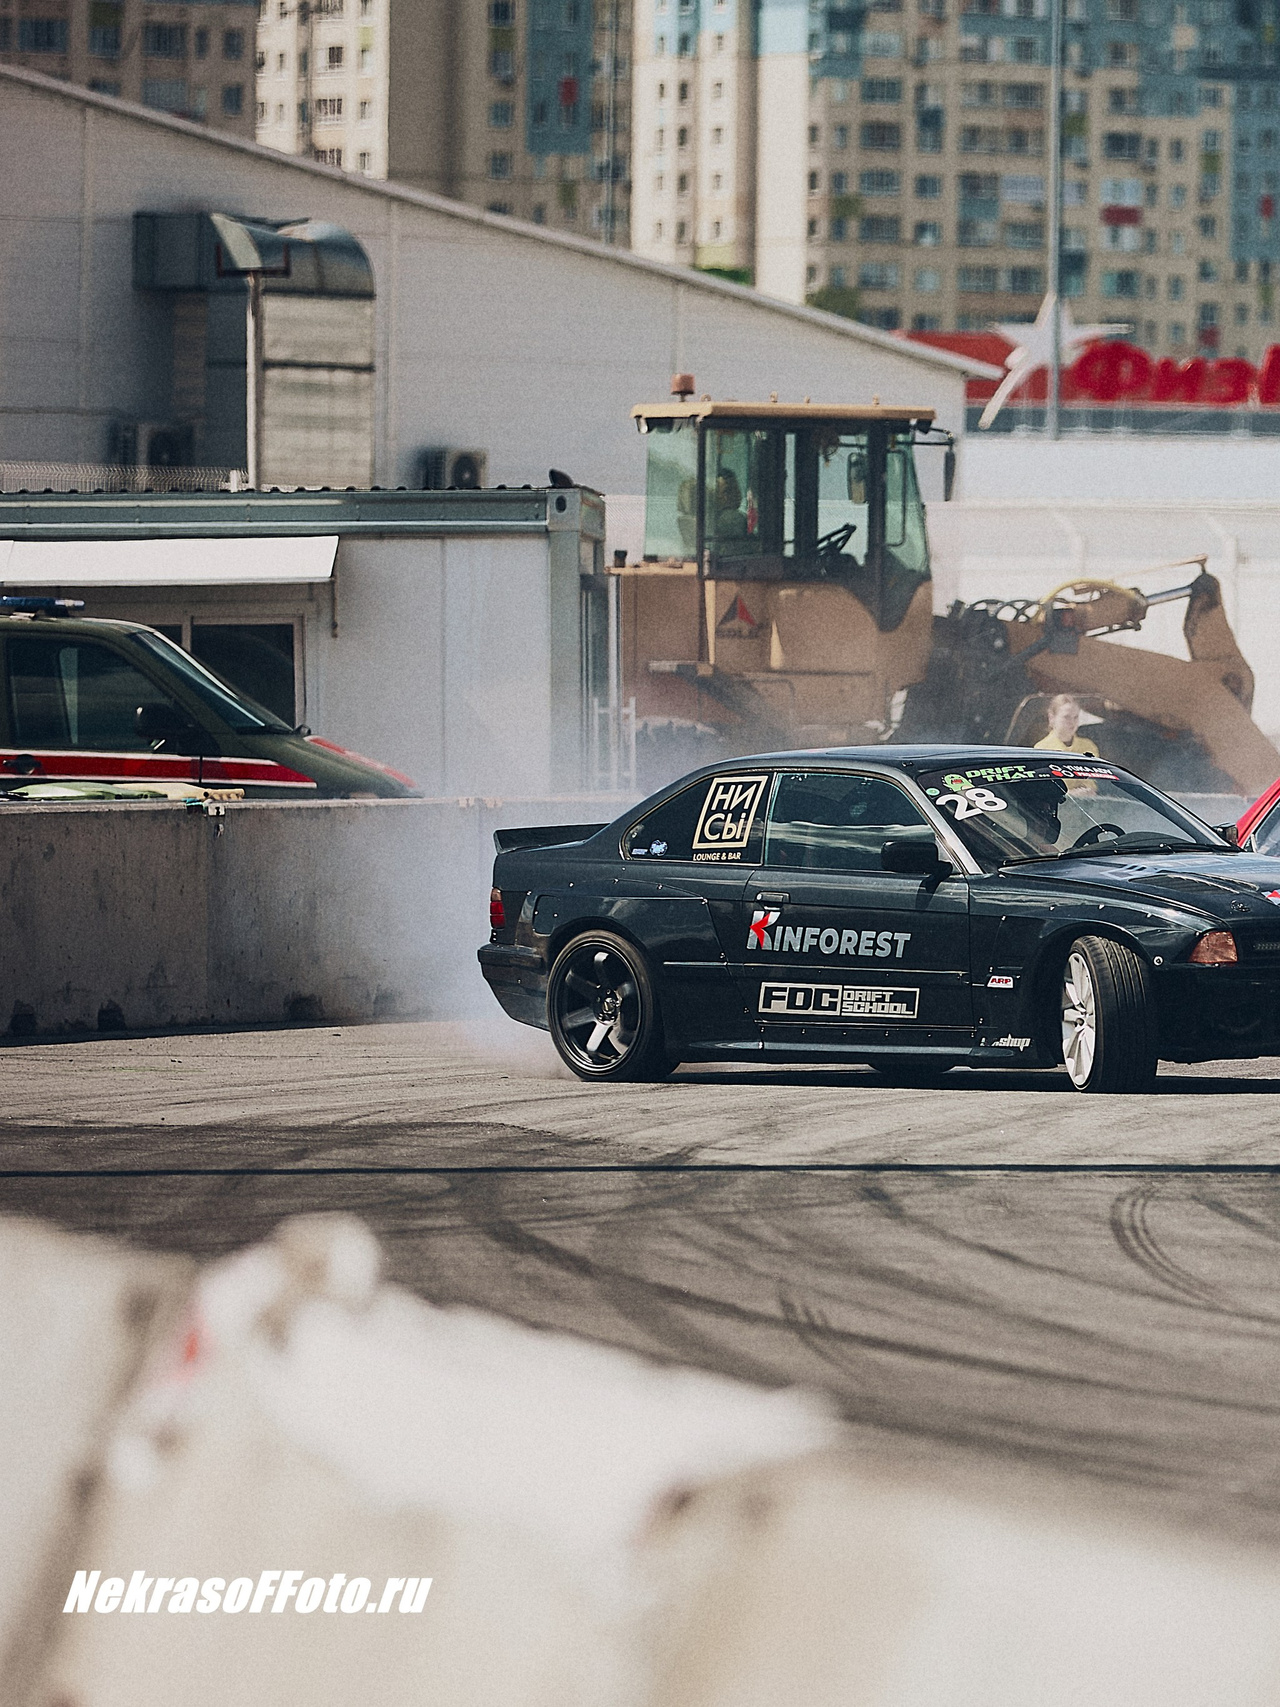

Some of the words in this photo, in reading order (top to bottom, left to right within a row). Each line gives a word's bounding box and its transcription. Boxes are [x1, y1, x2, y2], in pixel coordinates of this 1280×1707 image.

[965, 765, 1026, 779] DRIFT
[711, 783, 758, 811] НИ
[936, 788, 1008, 821] 28
[692, 853, 720, 862] LOUNGE
[728, 852, 741, 860] BAR
[746, 910, 912, 958] KINFOREST
[762, 986, 840, 1012] FDC
[842, 990, 894, 1002] DRIFT
[841, 1001, 914, 1014] SCHOOL
